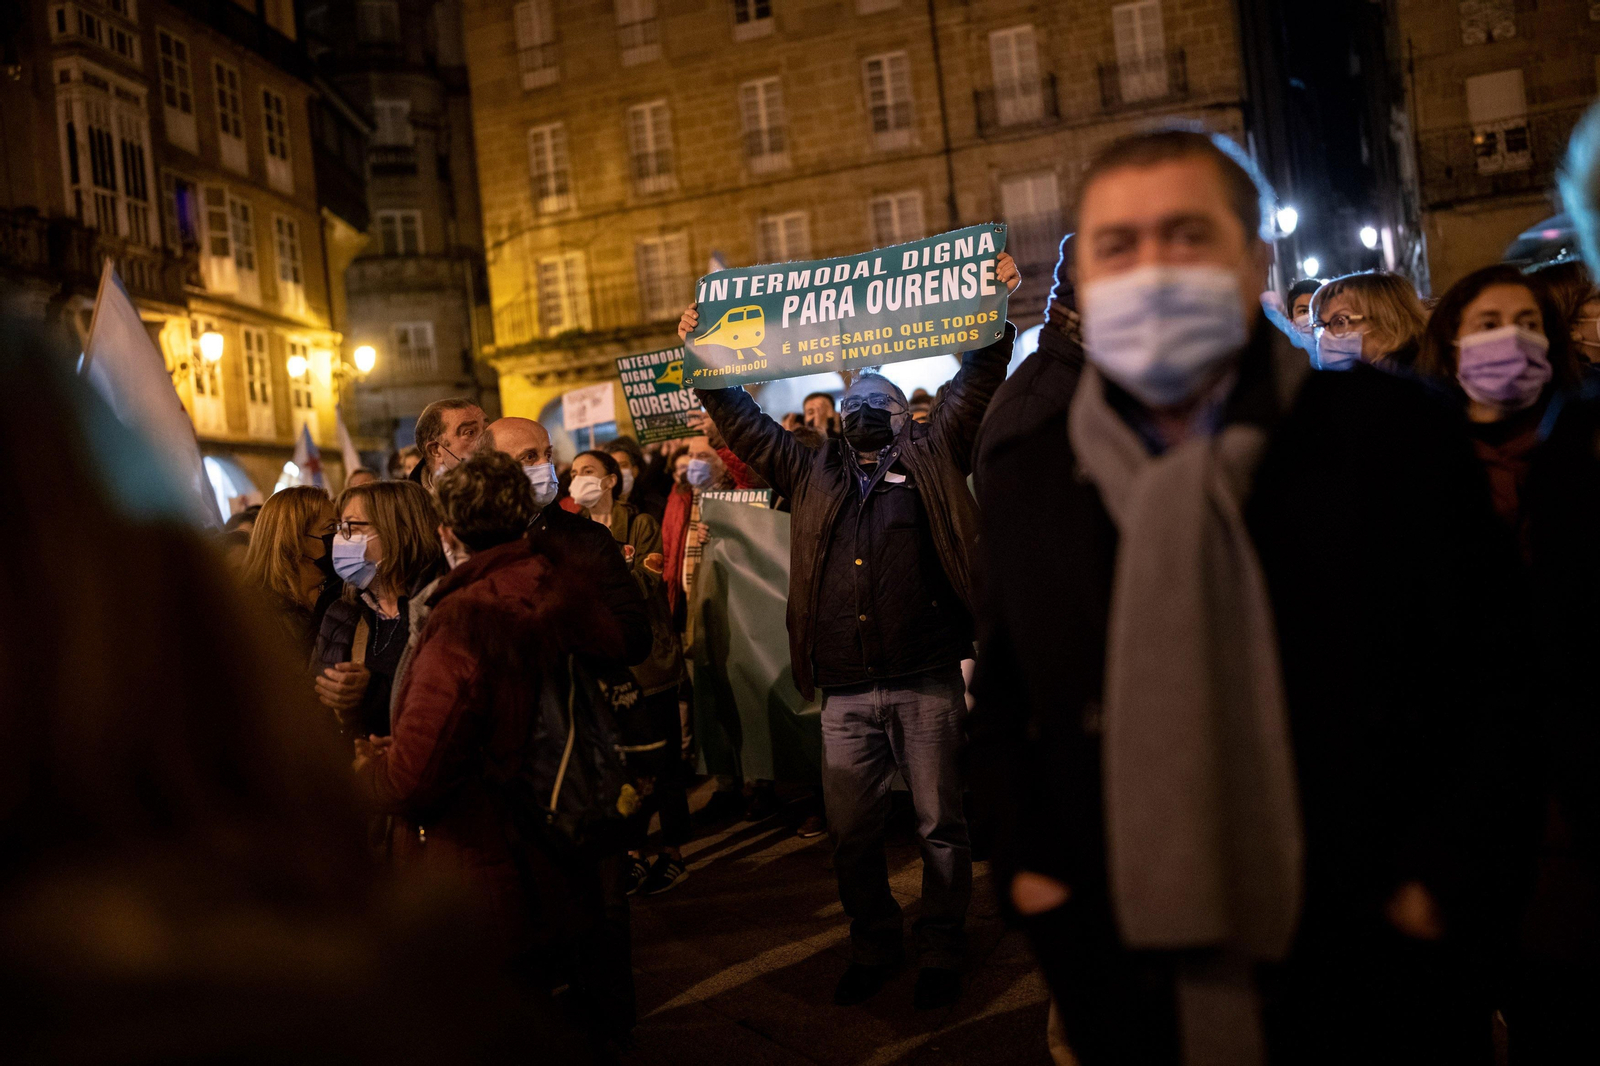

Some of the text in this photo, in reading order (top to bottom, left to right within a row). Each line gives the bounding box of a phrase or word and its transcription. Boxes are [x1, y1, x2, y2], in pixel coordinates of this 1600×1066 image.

[698, 232, 996, 303] INTERMODAL DIGNA
[782, 259, 997, 328] PARA OURENSE
[782, 310, 999, 354] É NECESARIO QUE TODOS
[802, 329, 980, 366] NOS INVOLUCREMOS
[620, 367, 656, 384] DIGNA
[692, 359, 768, 377] #TrenDignoOU
[624, 381, 656, 397] PARA
[629, 388, 700, 418] OURENSE
